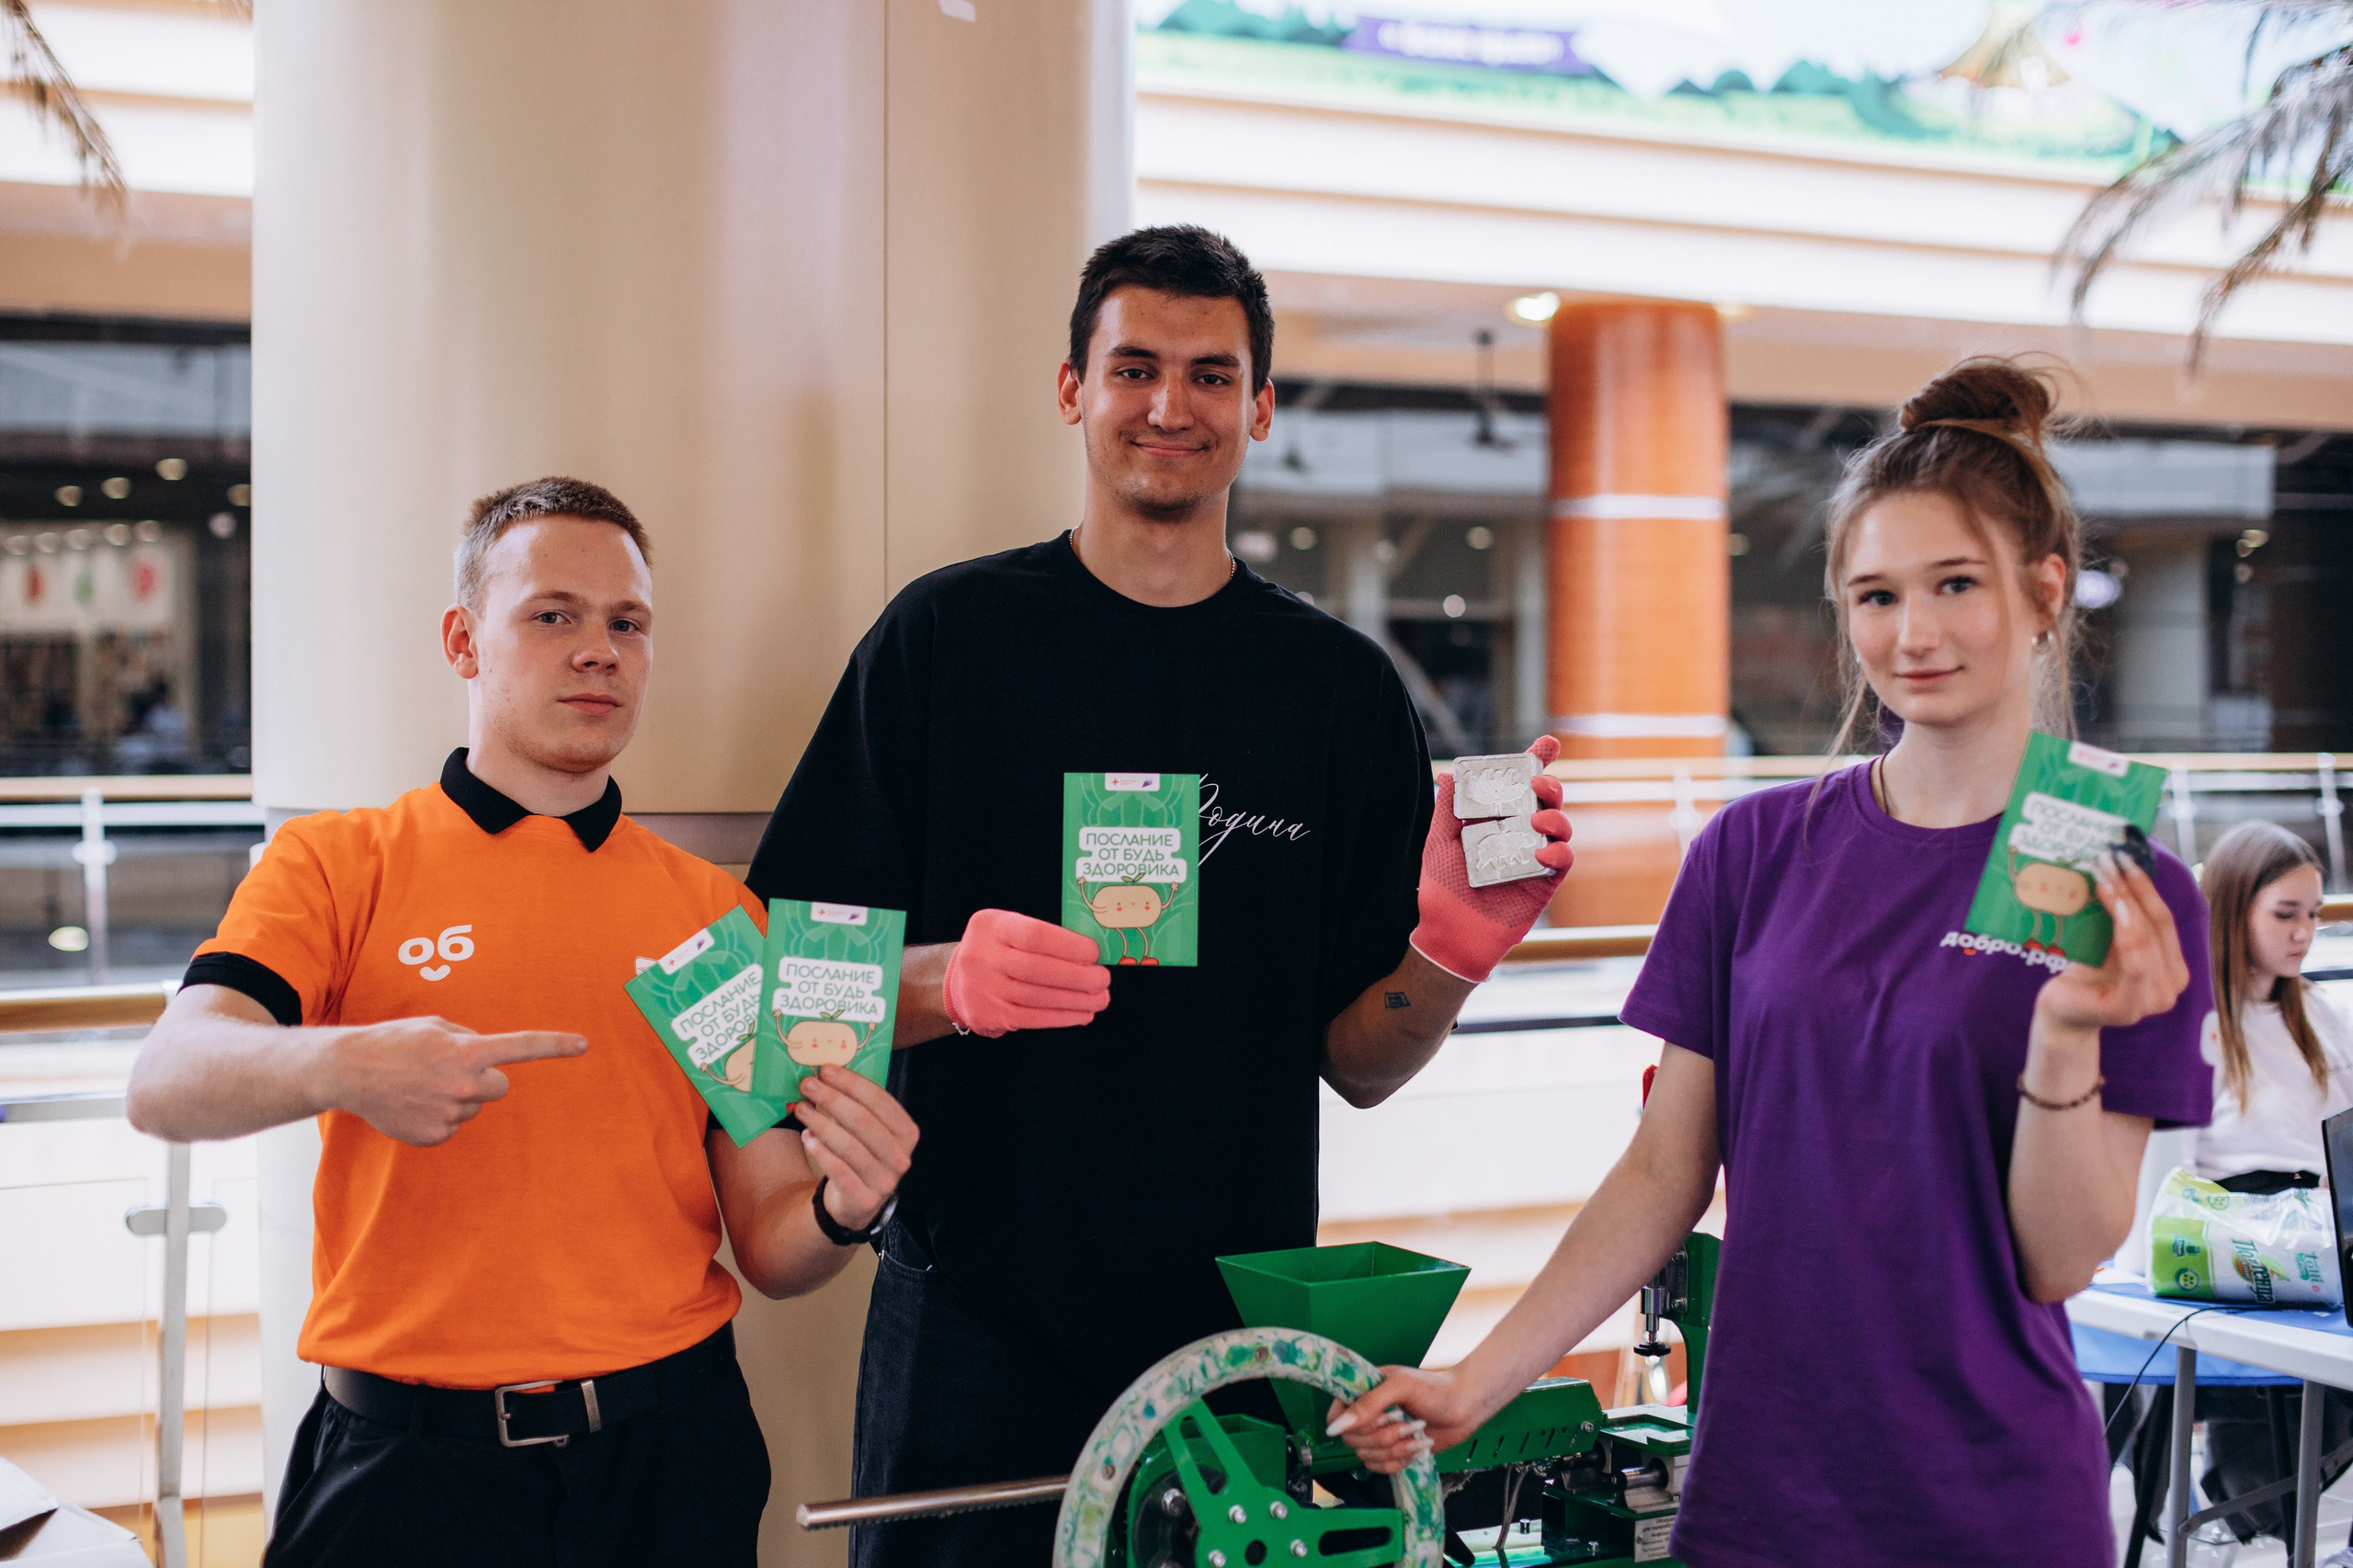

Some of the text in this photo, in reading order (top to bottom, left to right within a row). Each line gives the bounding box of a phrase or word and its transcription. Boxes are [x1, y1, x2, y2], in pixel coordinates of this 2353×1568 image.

[1086, 833, 1174, 846] ПОСЛАНИЕ
[1098, 847, 1165, 863] ОТ БУДЬ
[1083, 863, 1179, 878] ЗДОРОВИКА
[786, 963, 876, 984] ПОСЛАНИЕ
[798, 981, 866, 1000] ОТ БУДЬ
[679, 971, 761, 1033] ПОСЛАНИЕ
[779, 994, 879, 1015] ЗДОРОВИКА
[695, 1011, 756, 1060] ЗДОРОВ
[700, 1017, 721, 1037] ОТ
